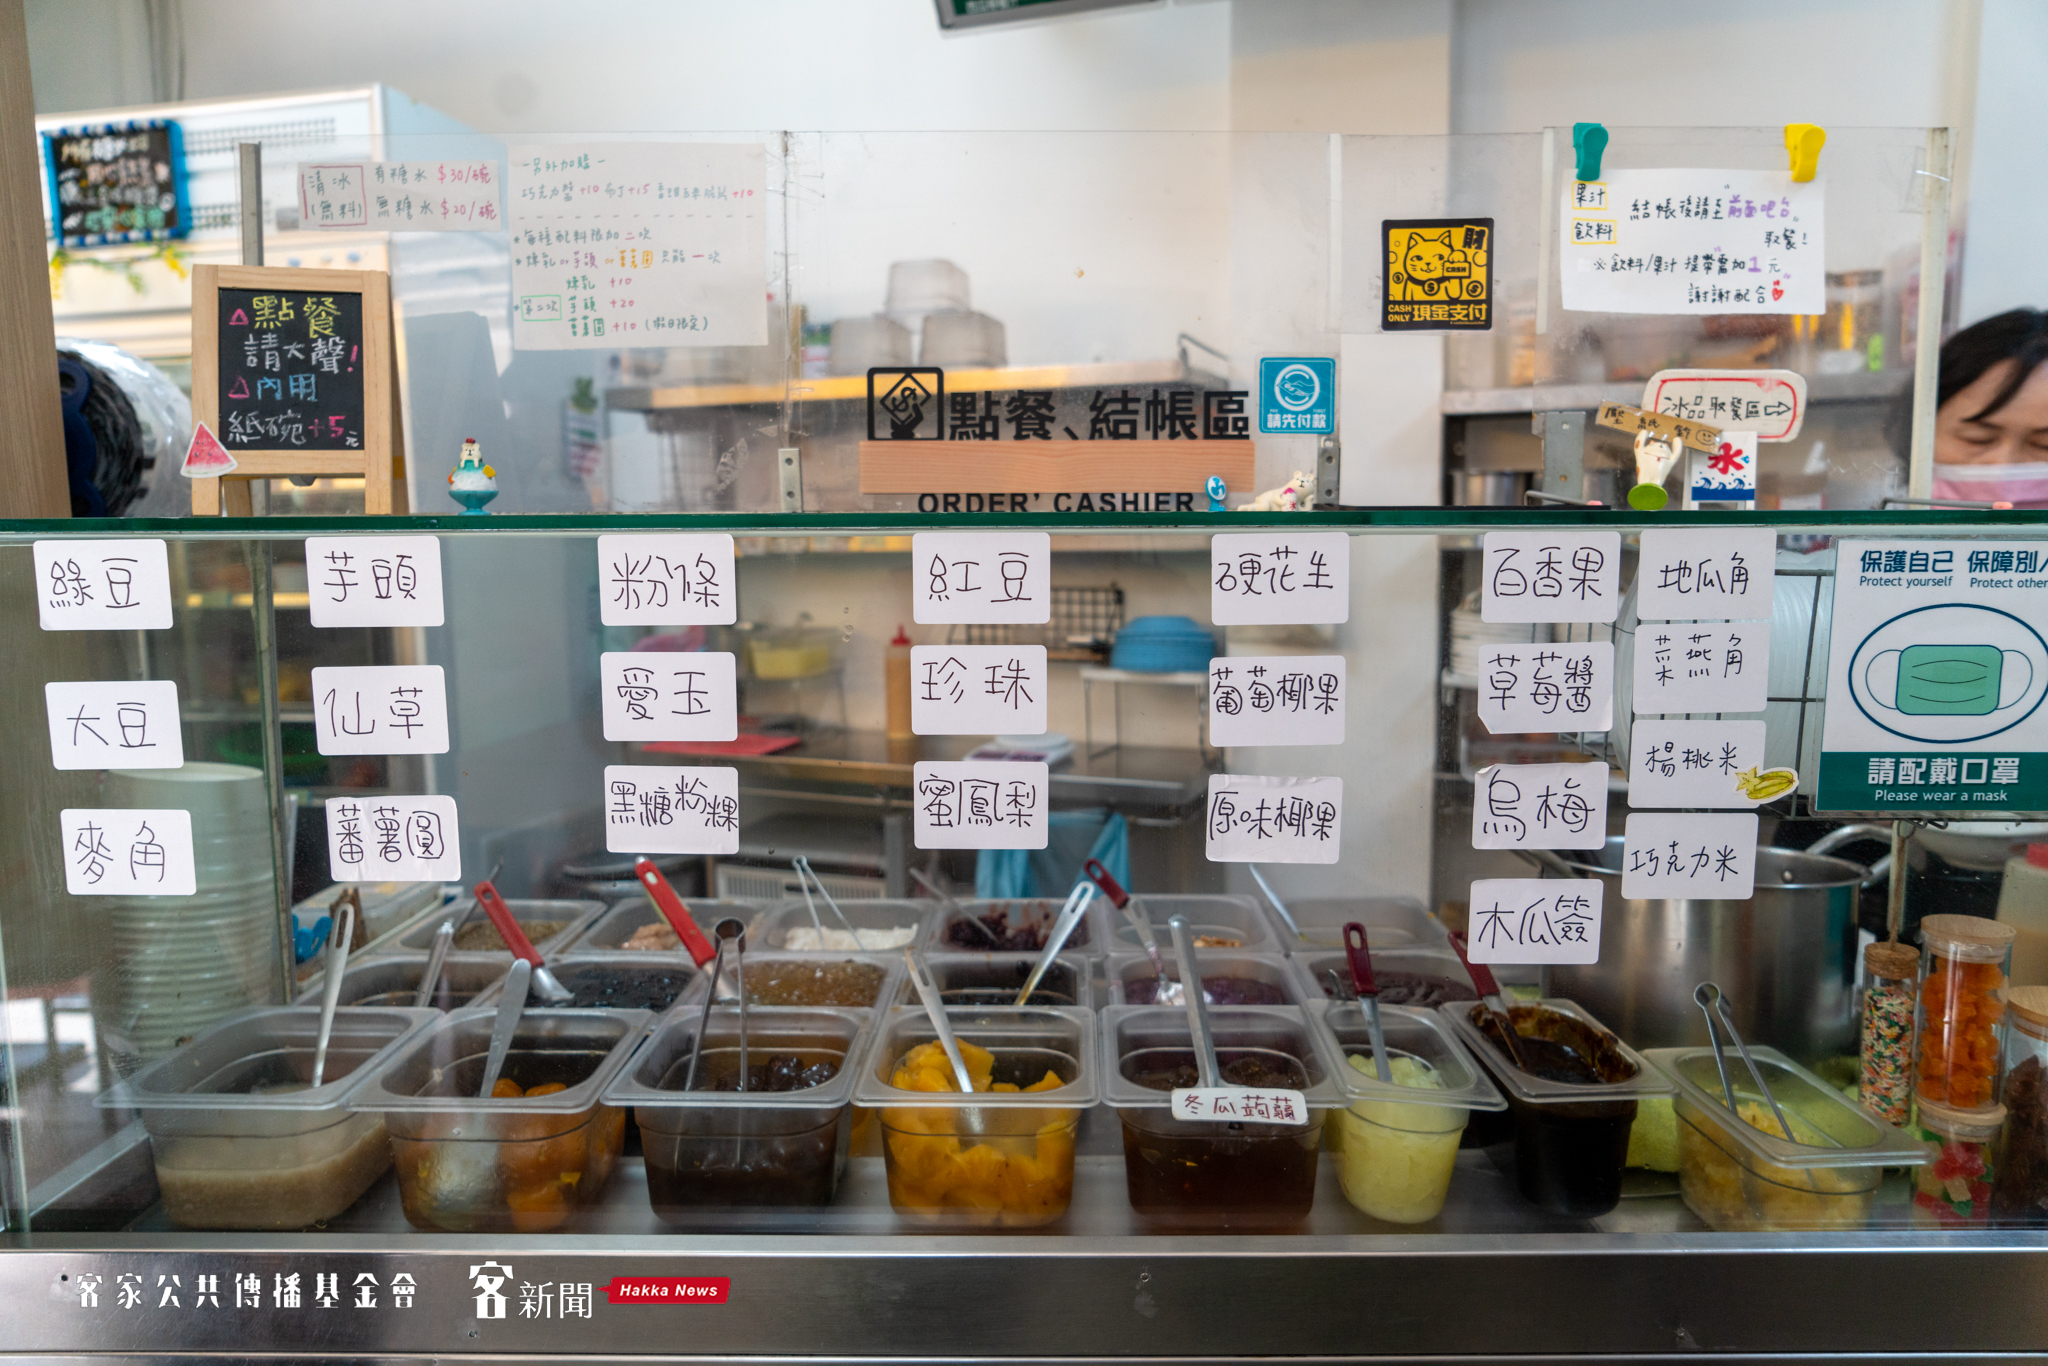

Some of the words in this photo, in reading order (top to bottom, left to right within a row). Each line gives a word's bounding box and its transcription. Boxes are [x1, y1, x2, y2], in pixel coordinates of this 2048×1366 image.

[375, 164, 427, 185] 有糖水
[580, 185, 600, 195] +10
[604, 182, 624, 199] 布丁
[628, 183, 650, 196] +15
[733, 188, 754, 199] +10
[311, 200, 362, 221] (無料)
[376, 195, 433, 220] 無糖水
[1575, 183, 1605, 207] 果汁
[1573, 222, 1613, 241] 飲料
[610, 276, 632, 288] +10
[1688, 283, 1766, 304] 謝謝配合
[252, 295, 342, 339] 點餐
[568, 295, 597, 314] 芋頭
[610, 299, 635, 310] +20
[1388, 304, 1411, 313] CASH
[1388, 314, 1410, 323] ONLY
[1412, 304, 1487, 321] 現金支付
[613, 321, 637, 333] +10
[244, 332, 359, 375] 請大聲!
[257, 373, 319, 403] 內用
[949, 390, 1251, 441] 點餐、結帳區
[1267, 413, 1327, 429] 請先付款
[1661, 396, 1761, 421] 冰品取餐區
[1053, 492, 1195, 512] CASHIER
[323, 550, 416, 603] 芋頭
[611, 552, 720, 610] 粉條
[928, 552, 1032, 603] 紅豆
[1214, 545, 1334, 596] 硬花生
[1493, 546, 1604, 601] 百香果
[1657, 551, 1749, 595] 地瓜角
[1860, 550, 1954, 573] 保護自己
[50, 557, 140, 609] 綠豆
[1859, 576, 1902, 587] Protect
[1906, 576, 1953, 588] yourself
[1970, 578, 2013, 588] Protect
[1654, 633, 1743, 687] 菜燕角
[617, 667, 711, 720] 愛玉
[921, 656, 1034, 710] 珍珠
[1211, 665, 1339, 716] 葡萄椰果
[1487, 651, 1594, 715] 草莓醬
[66, 702, 157, 748] 大豆
[323, 686, 424, 739] 仙草
[1644, 741, 1738, 778] 楊桃米
[1868, 757, 2020, 785] 請配戴口罩
[610, 774, 738, 832] 黑糖粉粿
[918, 773, 1036, 828] 蜜鳳梨
[1483, 769, 1596, 842] 烏梅
[1875, 790, 1917, 801] Please
[1923, 793, 1955, 801] wear
[1961, 793, 1968, 801] a
[1973, 790, 2007, 801] mask
[1209, 791, 1336, 842] 原味椰果
[76, 820, 165, 884] 麥角
[1629, 840, 1739, 882] 巧克力米
[1184, 1094, 1296, 1121] 冬瓜蒟蒻
